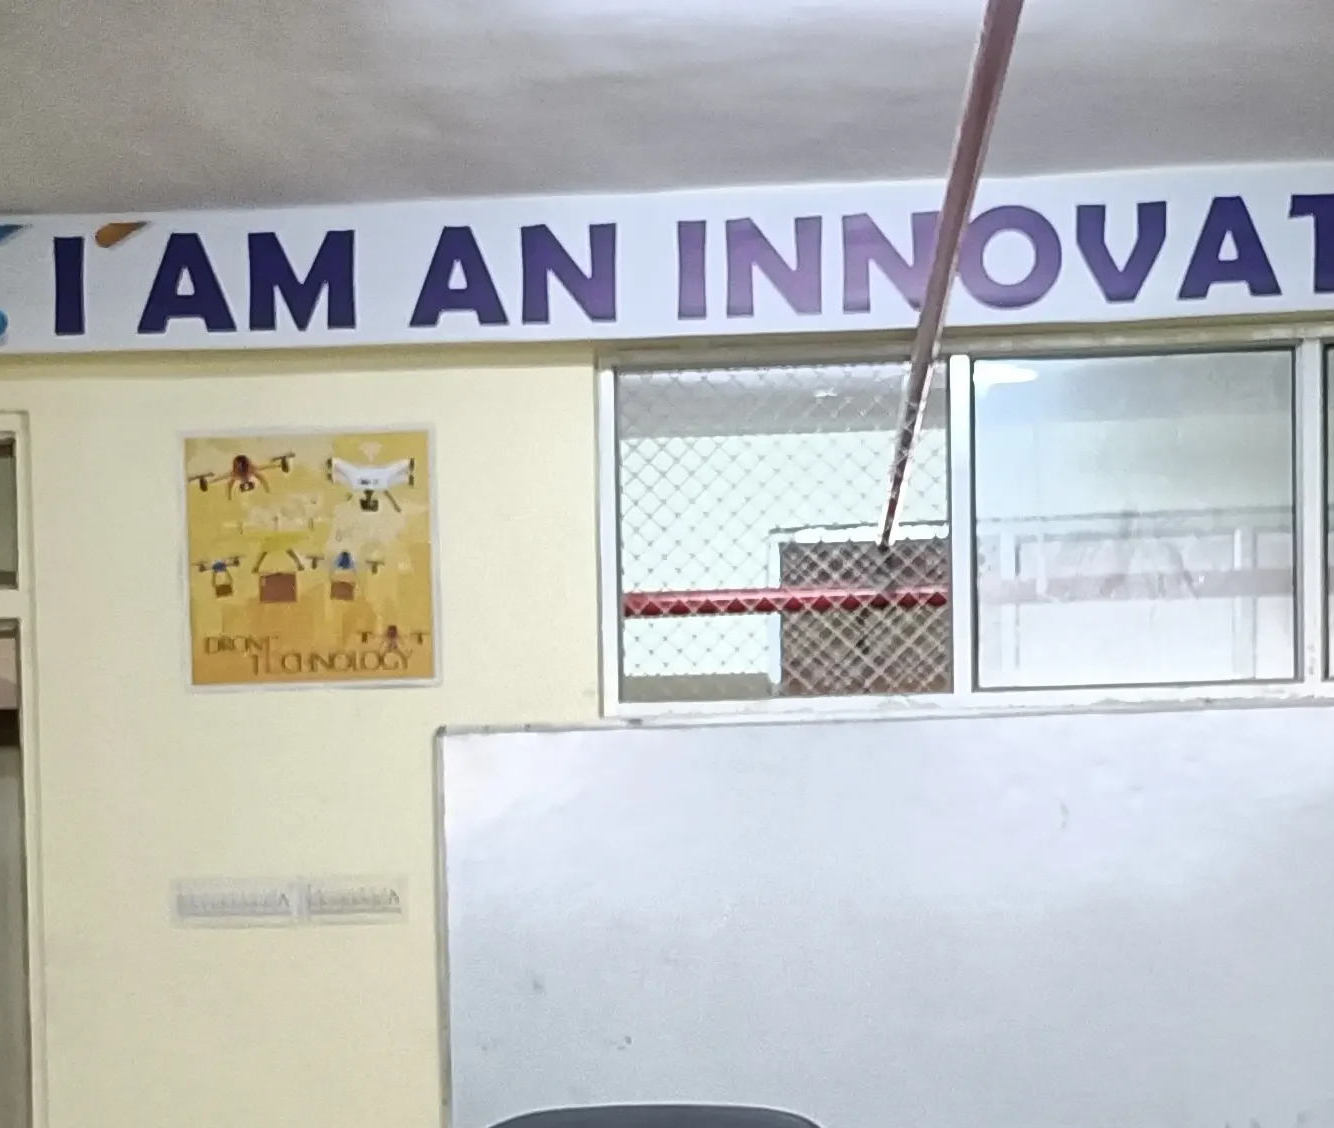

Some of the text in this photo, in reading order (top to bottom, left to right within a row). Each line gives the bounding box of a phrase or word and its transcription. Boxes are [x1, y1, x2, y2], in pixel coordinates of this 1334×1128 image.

[53, 236, 85, 336] I
[136, 229, 357, 335] AM
[408, 222, 617, 329] AN
